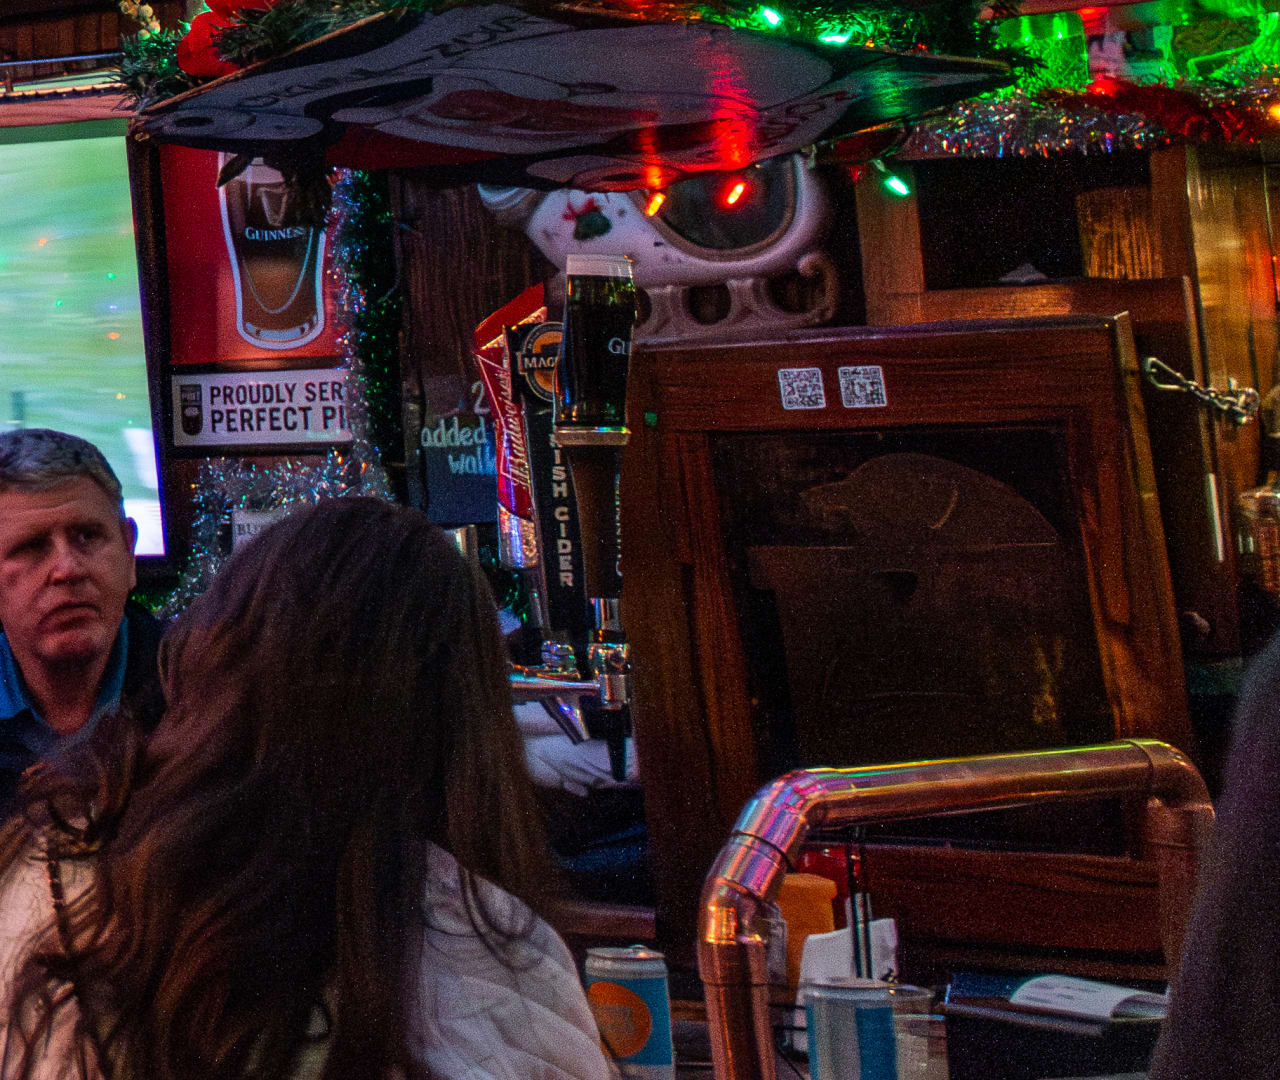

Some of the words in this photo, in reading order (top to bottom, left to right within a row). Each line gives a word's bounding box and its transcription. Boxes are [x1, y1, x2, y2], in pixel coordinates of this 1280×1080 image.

[210, 383, 296, 405] PROUDLY
[211, 406, 312, 433] PERFECT
[421, 416, 486, 448] added
[554, 506, 574, 588] CIDER
